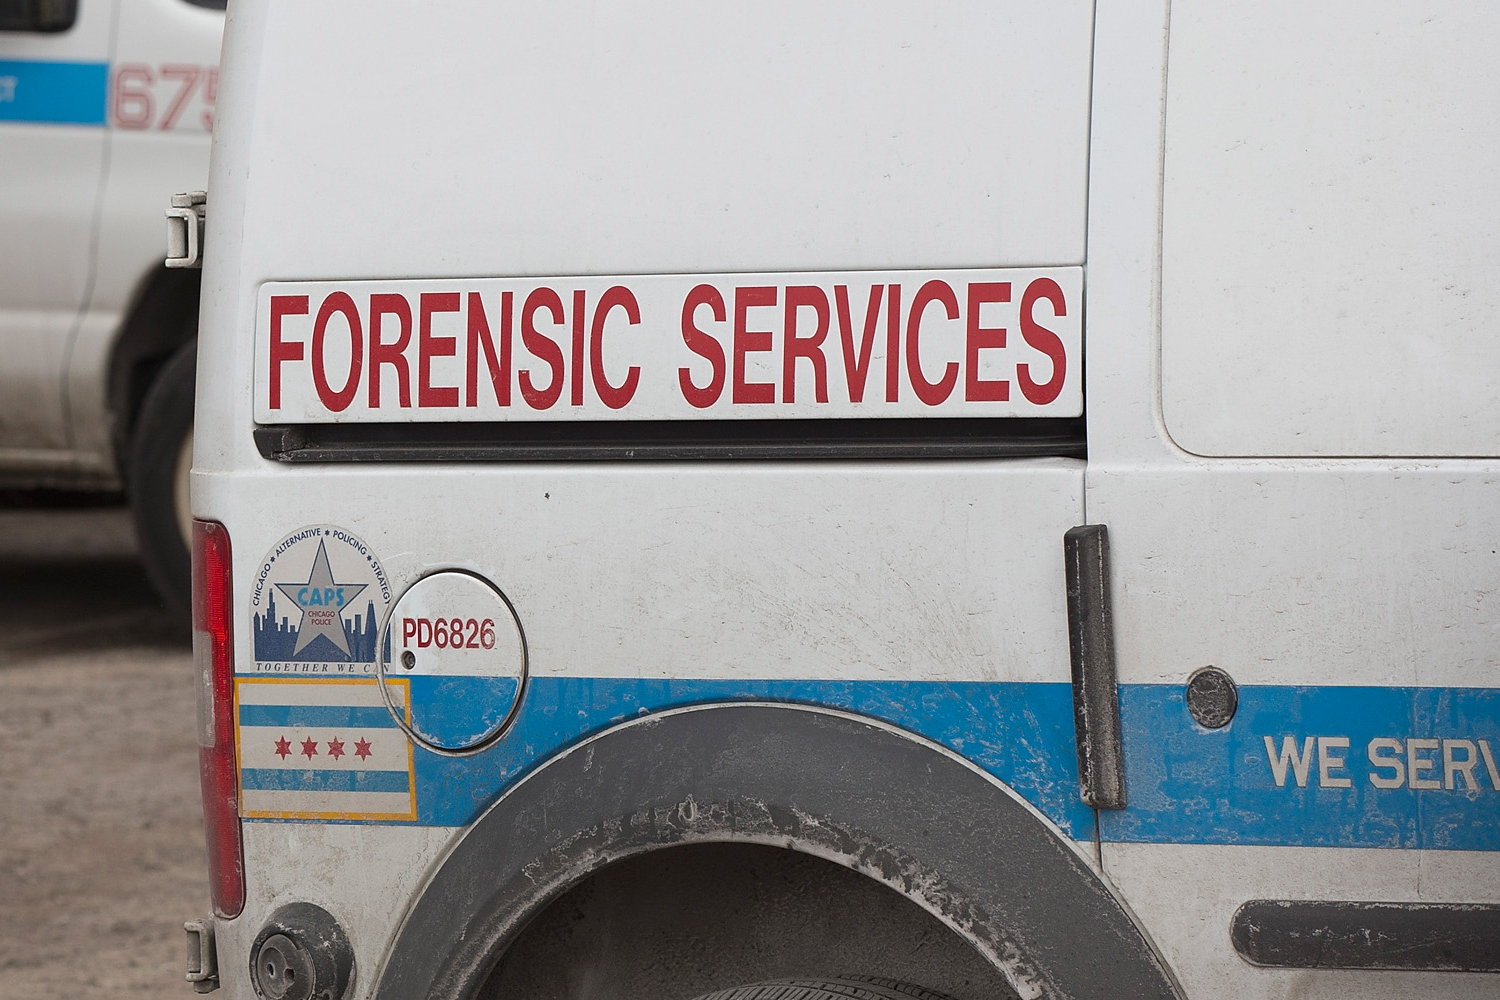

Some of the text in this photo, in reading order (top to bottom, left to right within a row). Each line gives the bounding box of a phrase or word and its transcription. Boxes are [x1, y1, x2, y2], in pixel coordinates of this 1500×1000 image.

[267, 277, 1069, 414] FORENSIC SERVICES
[252, 527, 391, 607] CHICAGO ALTERNATIVE POLICING STRATEGY
[297, 587, 345, 608] CAPS
[308, 610, 336, 618] CHICAGO
[311, 618, 332, 626] POLICE
[402, 617, 496, 649] PD6826
[256, 663, 391, 674] TOGETHER WE CN
[1263, 735, 1352, 788] WE
